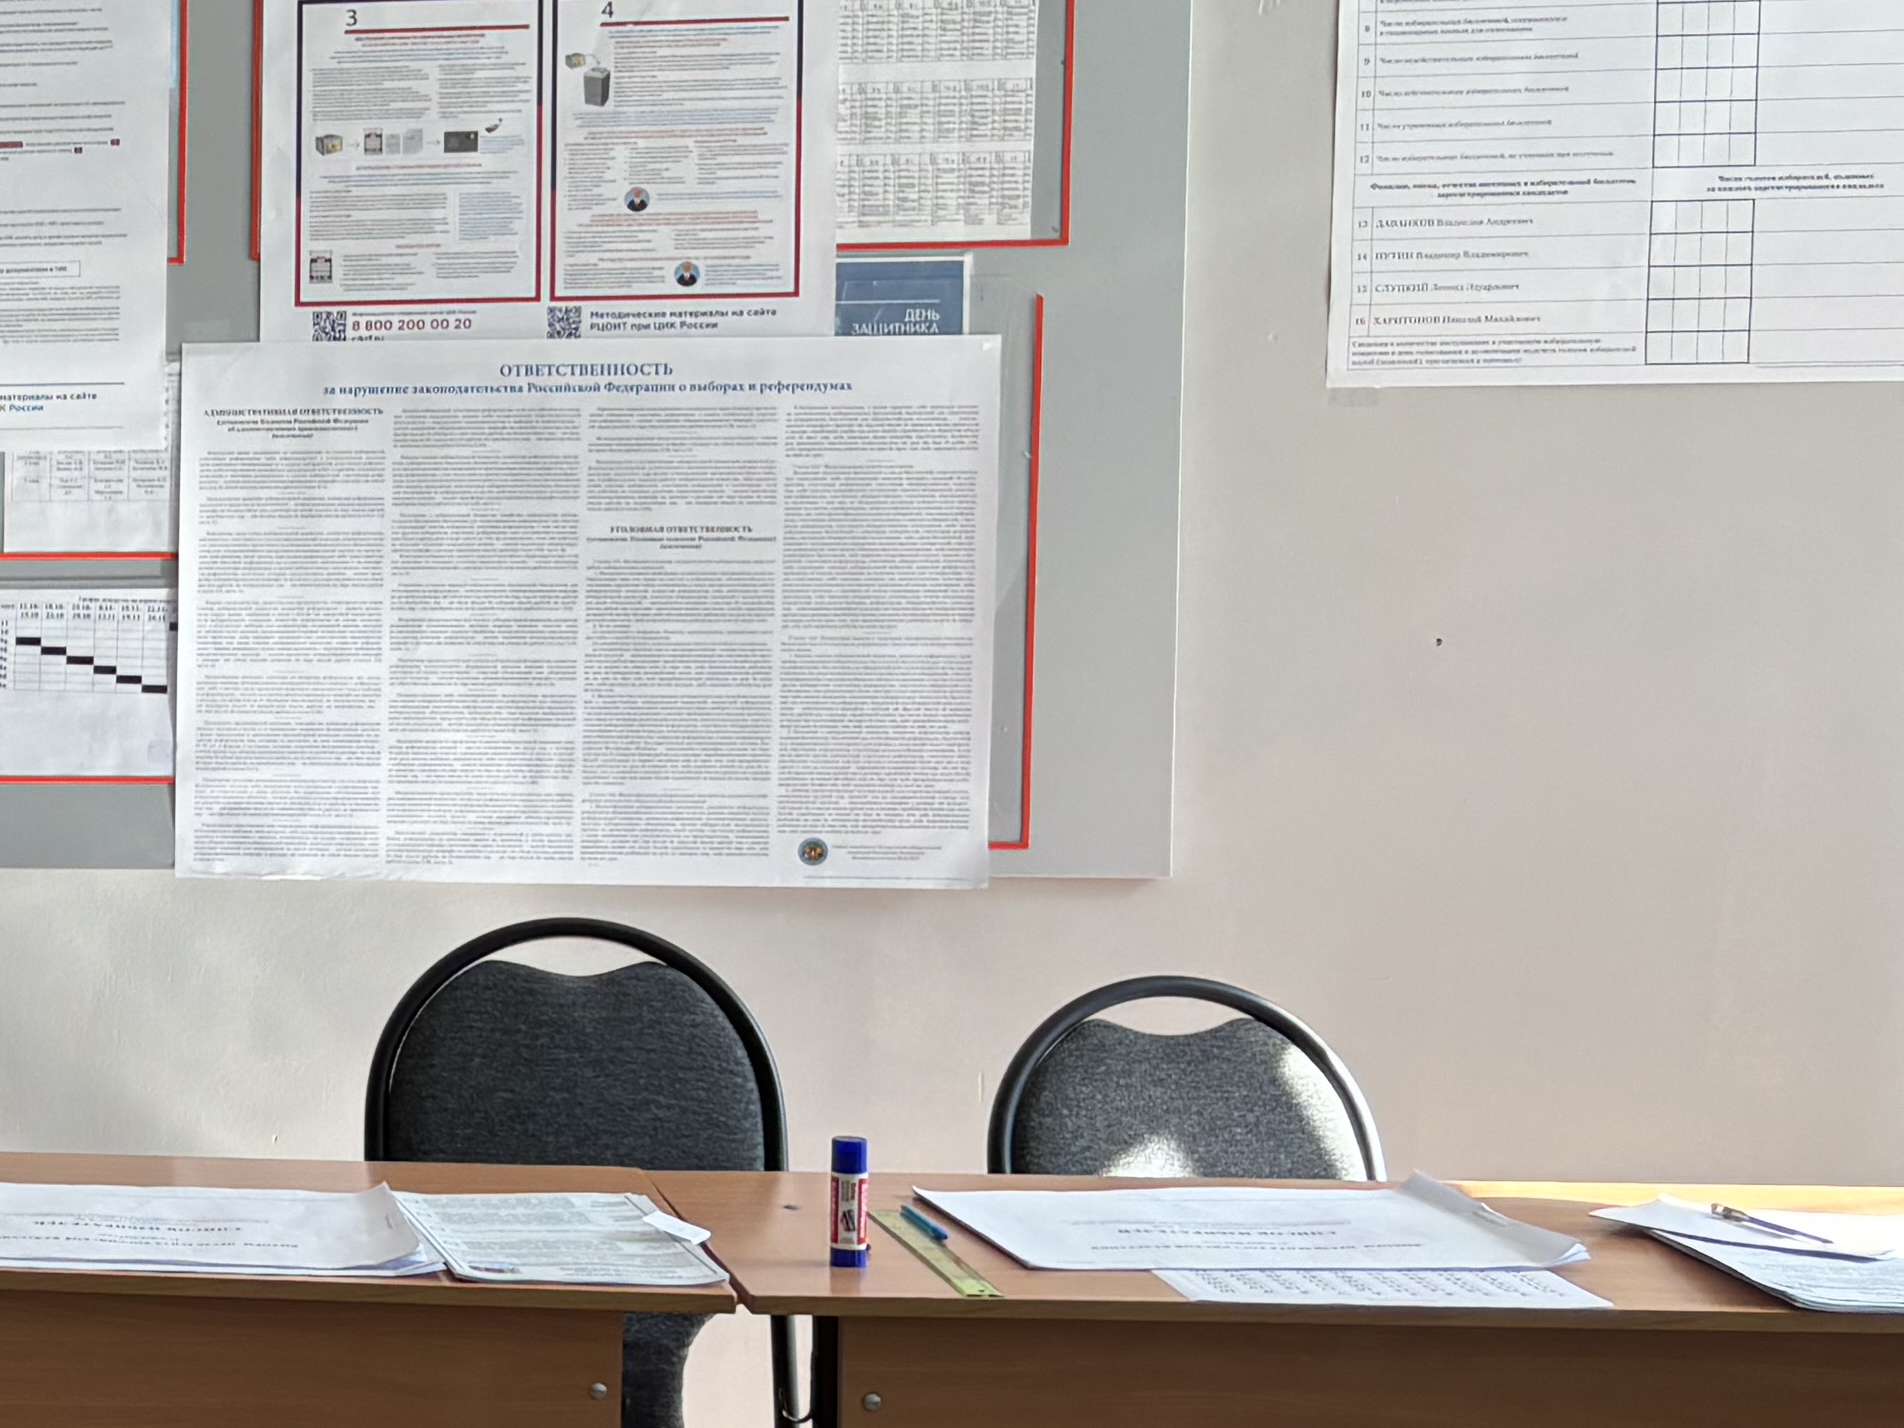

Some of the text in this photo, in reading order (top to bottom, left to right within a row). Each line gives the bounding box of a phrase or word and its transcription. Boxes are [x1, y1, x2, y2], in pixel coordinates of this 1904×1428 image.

[345, 9, 358, 26] 3
[601, 1, 614, 18] 4
[904, 308, 940, 323] ДЕНЬ
[352, 318, 472, 332] 8 800 200 00 20
[851, 322, 940, 336] ЗАЩИТНИКА
[499, 362, 674, 378] ОТВЕТСТВЕННОСТЬ
[339, 385, 409, 398] нарушение
[412, 383, 523, 396] законодательства
[527, 381, 600, 394] Российской
[604, 381, 675, 396] Федерации
[760, 380, 852, 395] референдумах
